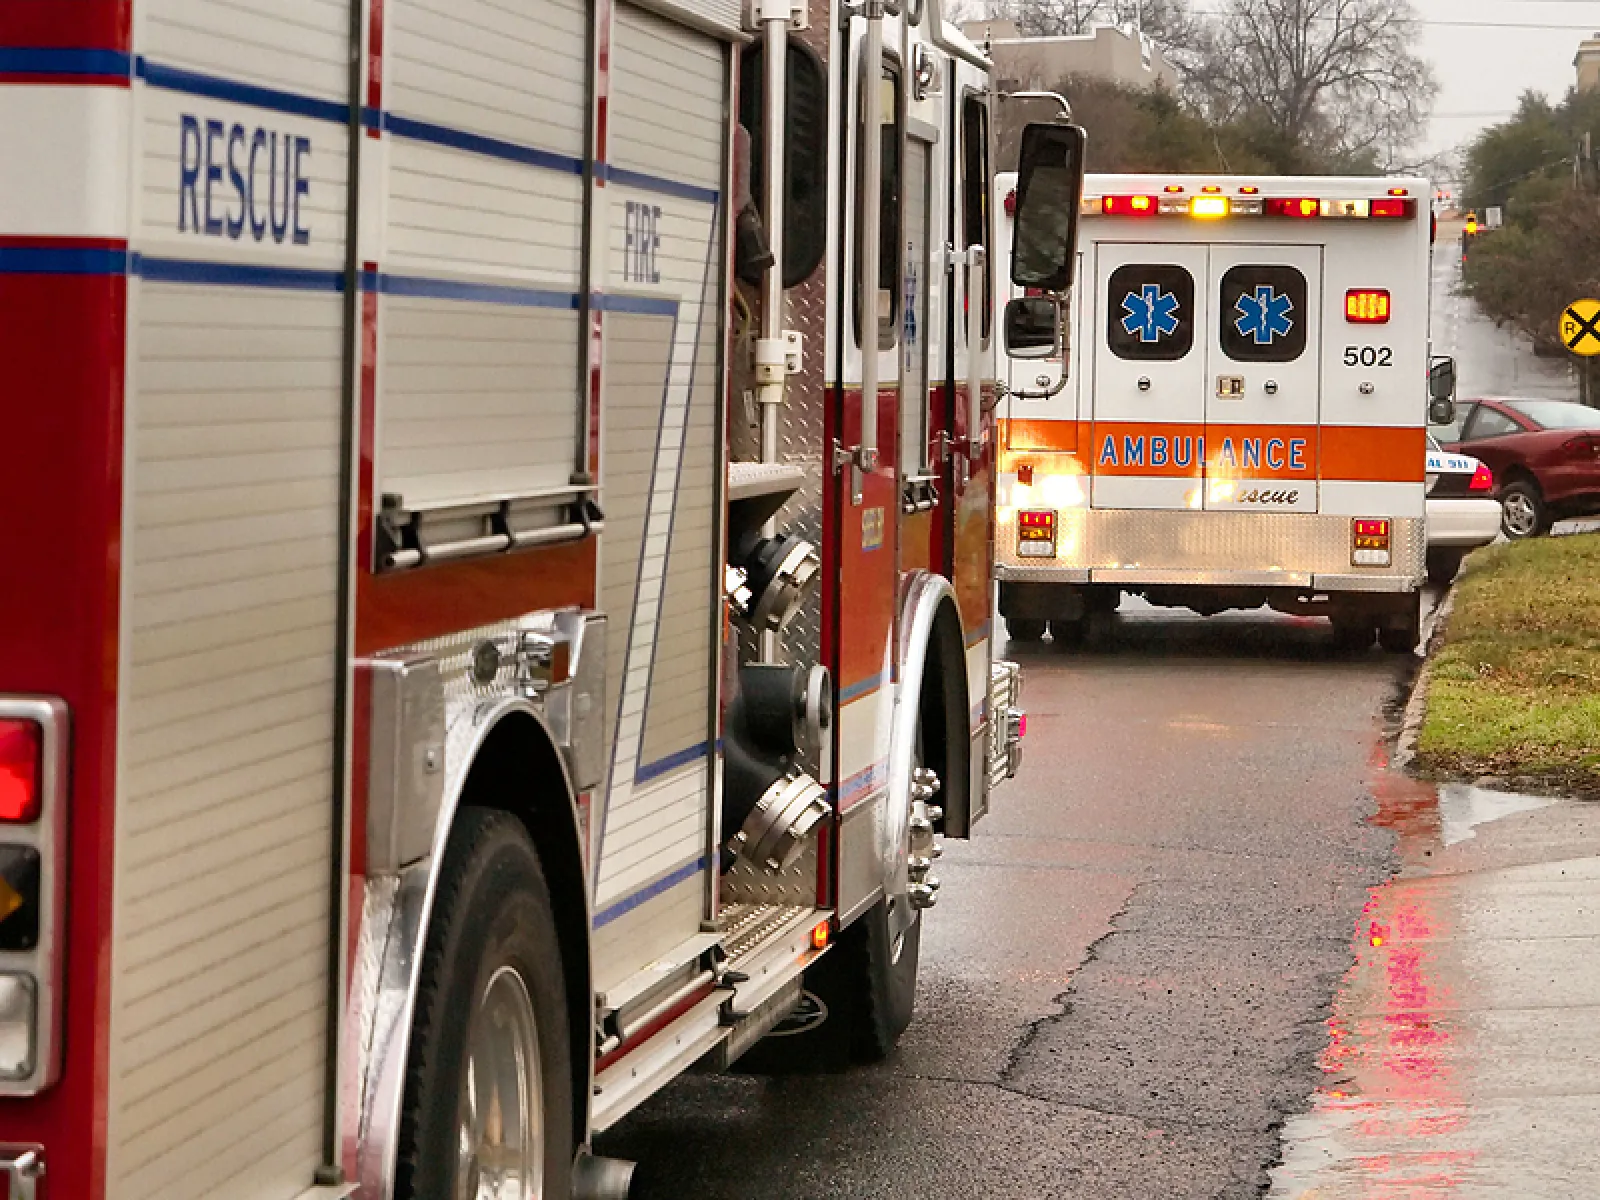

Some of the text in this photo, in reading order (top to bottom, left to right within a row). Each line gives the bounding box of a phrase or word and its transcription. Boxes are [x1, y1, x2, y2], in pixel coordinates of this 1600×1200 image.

[178, 113, 311, 246] RESCUE
[623, 200, 662, 284] FIRE
[1563, 321, 1577, 335] R
[1343, 345, 1393, 367] 502
[1098, 434, 1307, 470] AMBULANCE
